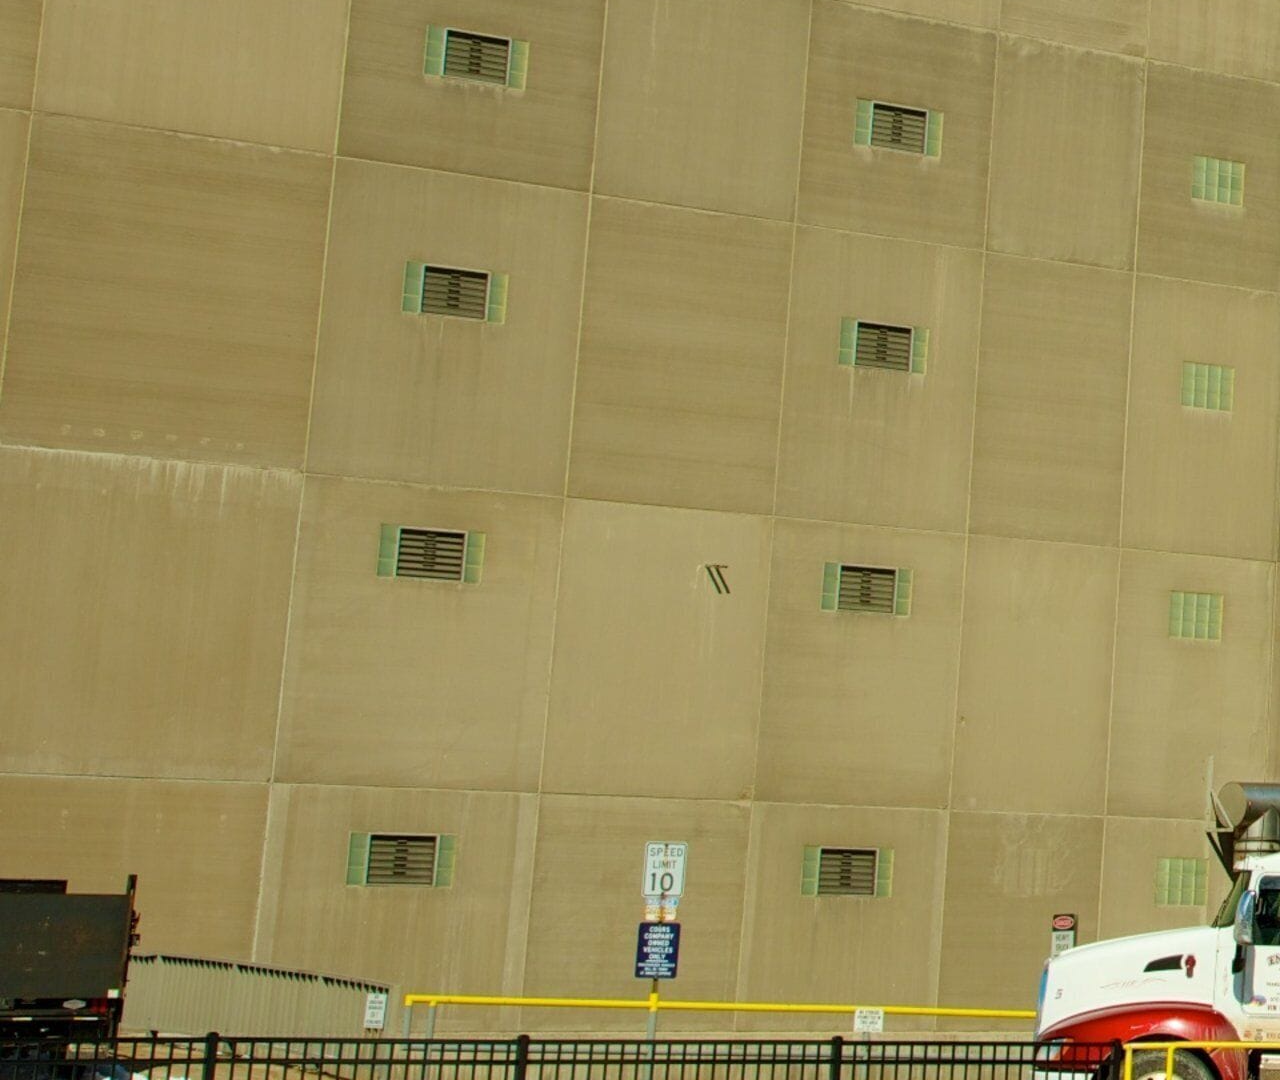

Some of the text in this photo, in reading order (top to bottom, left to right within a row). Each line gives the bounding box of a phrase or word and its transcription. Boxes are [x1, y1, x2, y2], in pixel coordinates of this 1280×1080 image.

[650, 847, 683, 857] SPEED
[652, 860, 677, 869] LIMIT
[651, 872, 674, 891] 10
[644, 932, 674, 940] COMPANY
